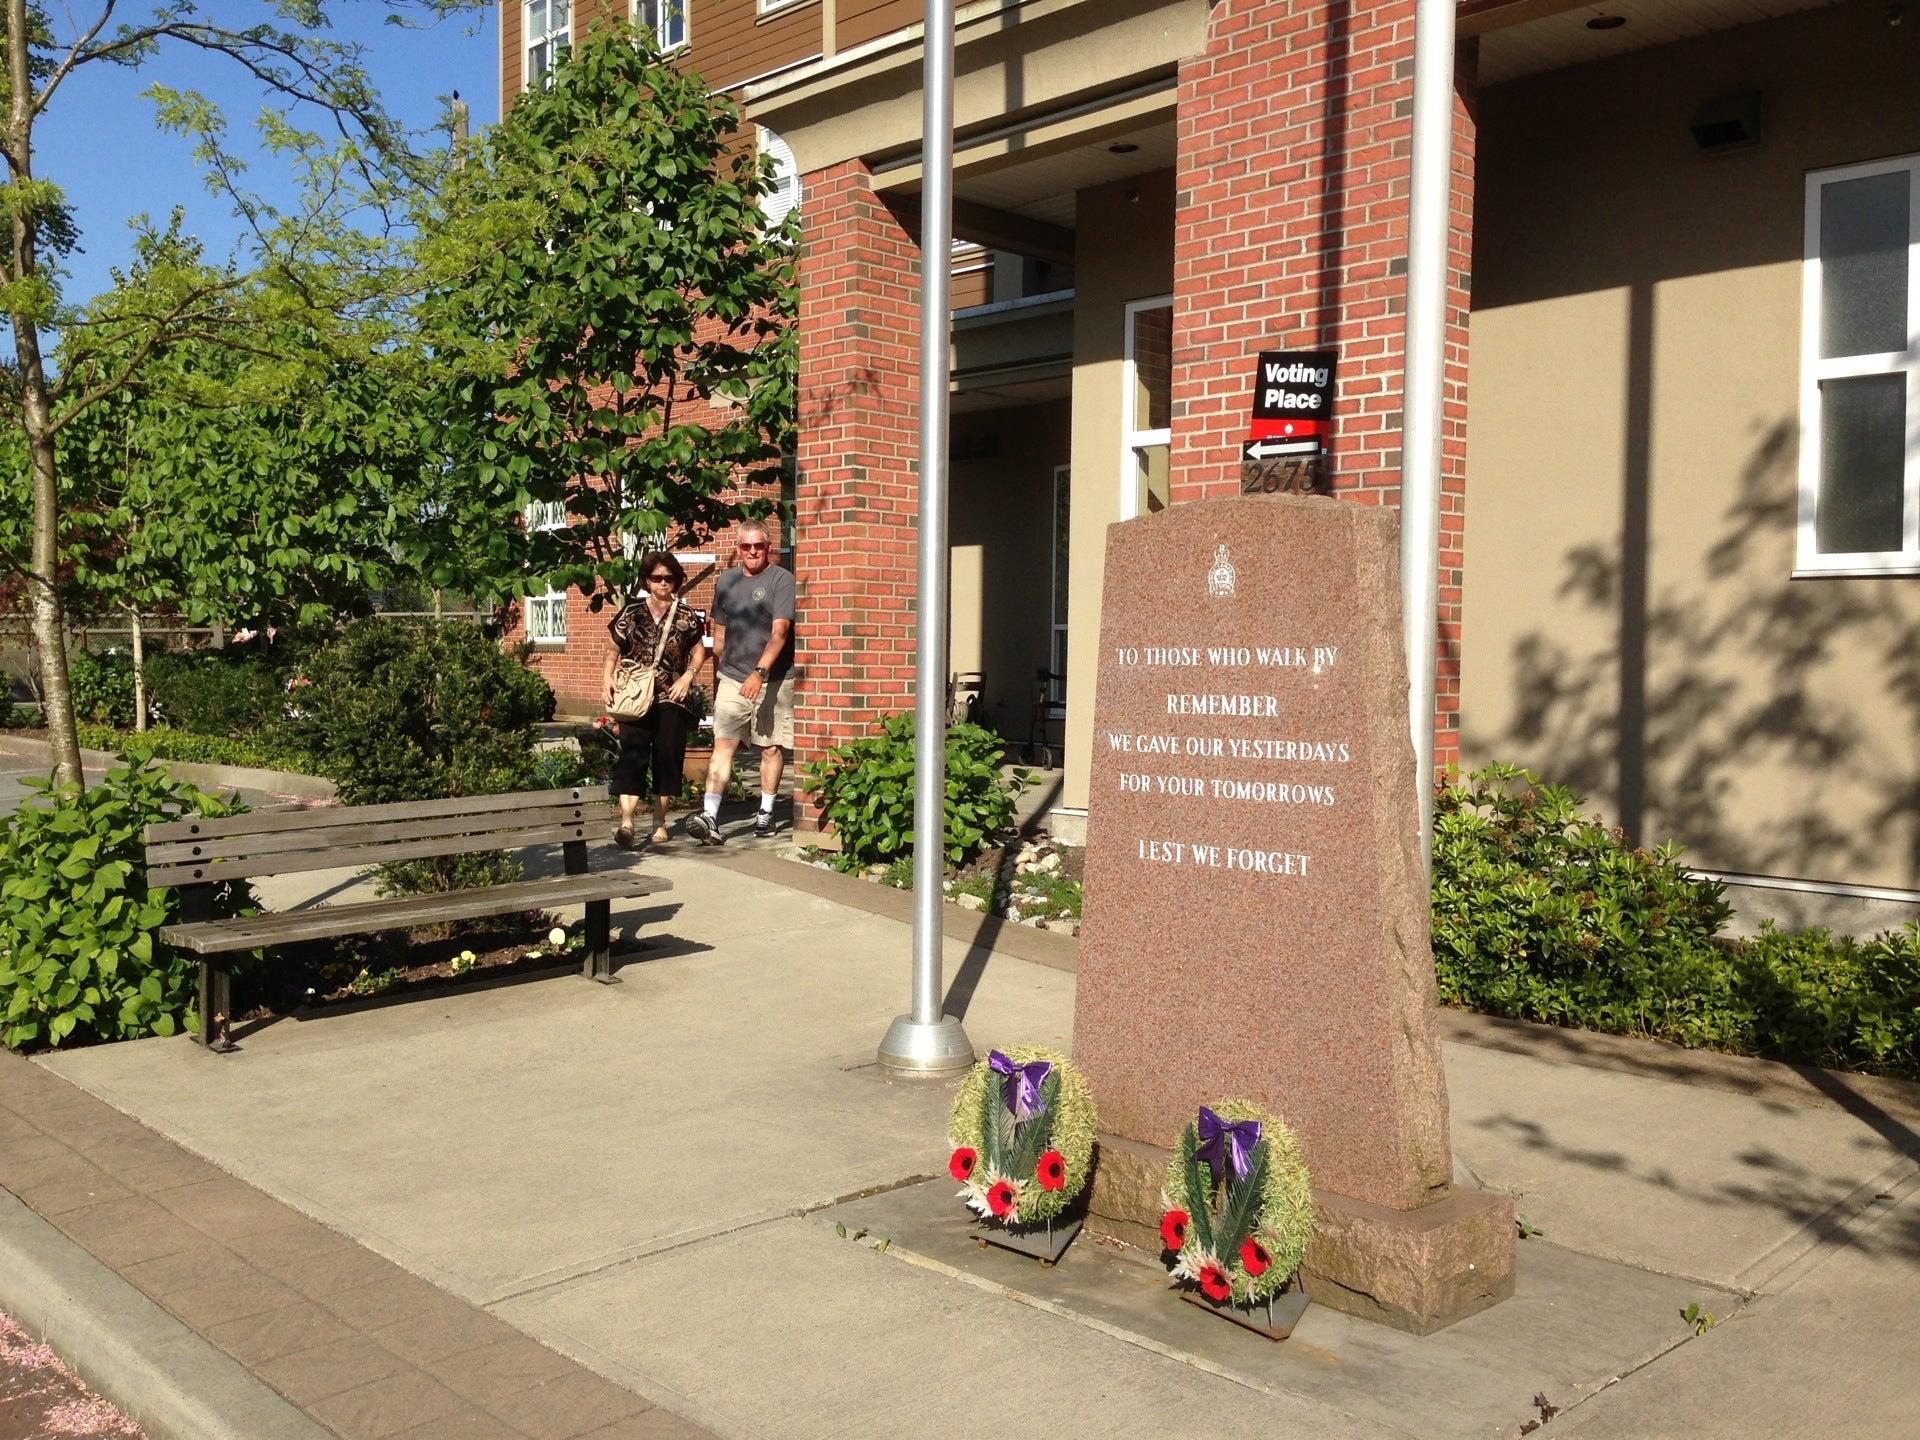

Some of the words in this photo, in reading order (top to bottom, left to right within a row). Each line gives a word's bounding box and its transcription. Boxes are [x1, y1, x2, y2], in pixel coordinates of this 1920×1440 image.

[1265, 363, 1329, 388] Voting
[1264, 389, 1322, 409] Place
[1116, 648, 1139, 665] TO
[1144, 648, 1202, 666] THOSE
[1207, 647, 1251, 666] WHO
[1256, 647, 1307, 666] WALK
[1314, 647, 1338, 666] BY
[1167, 694, 1279, 717] REMEMBER
[1108, 733, 1132, 752] WE
[1136, 735, 1181, 755] GAVE
[1186, 737, 1224, 757] OUR
[1229, 739, 1350, 762] YESTERDAYS
[1119, 773, 1151, 793] FOR
[1156, 775, 1205, 797] YOUR
[1211, 779, 1335, 806] TOMORROWS
[1138, 839, 1186, 864] LEST
[1191, 844, 1221, 868] WE
[1227, 848, 1311, 876] FORGET
